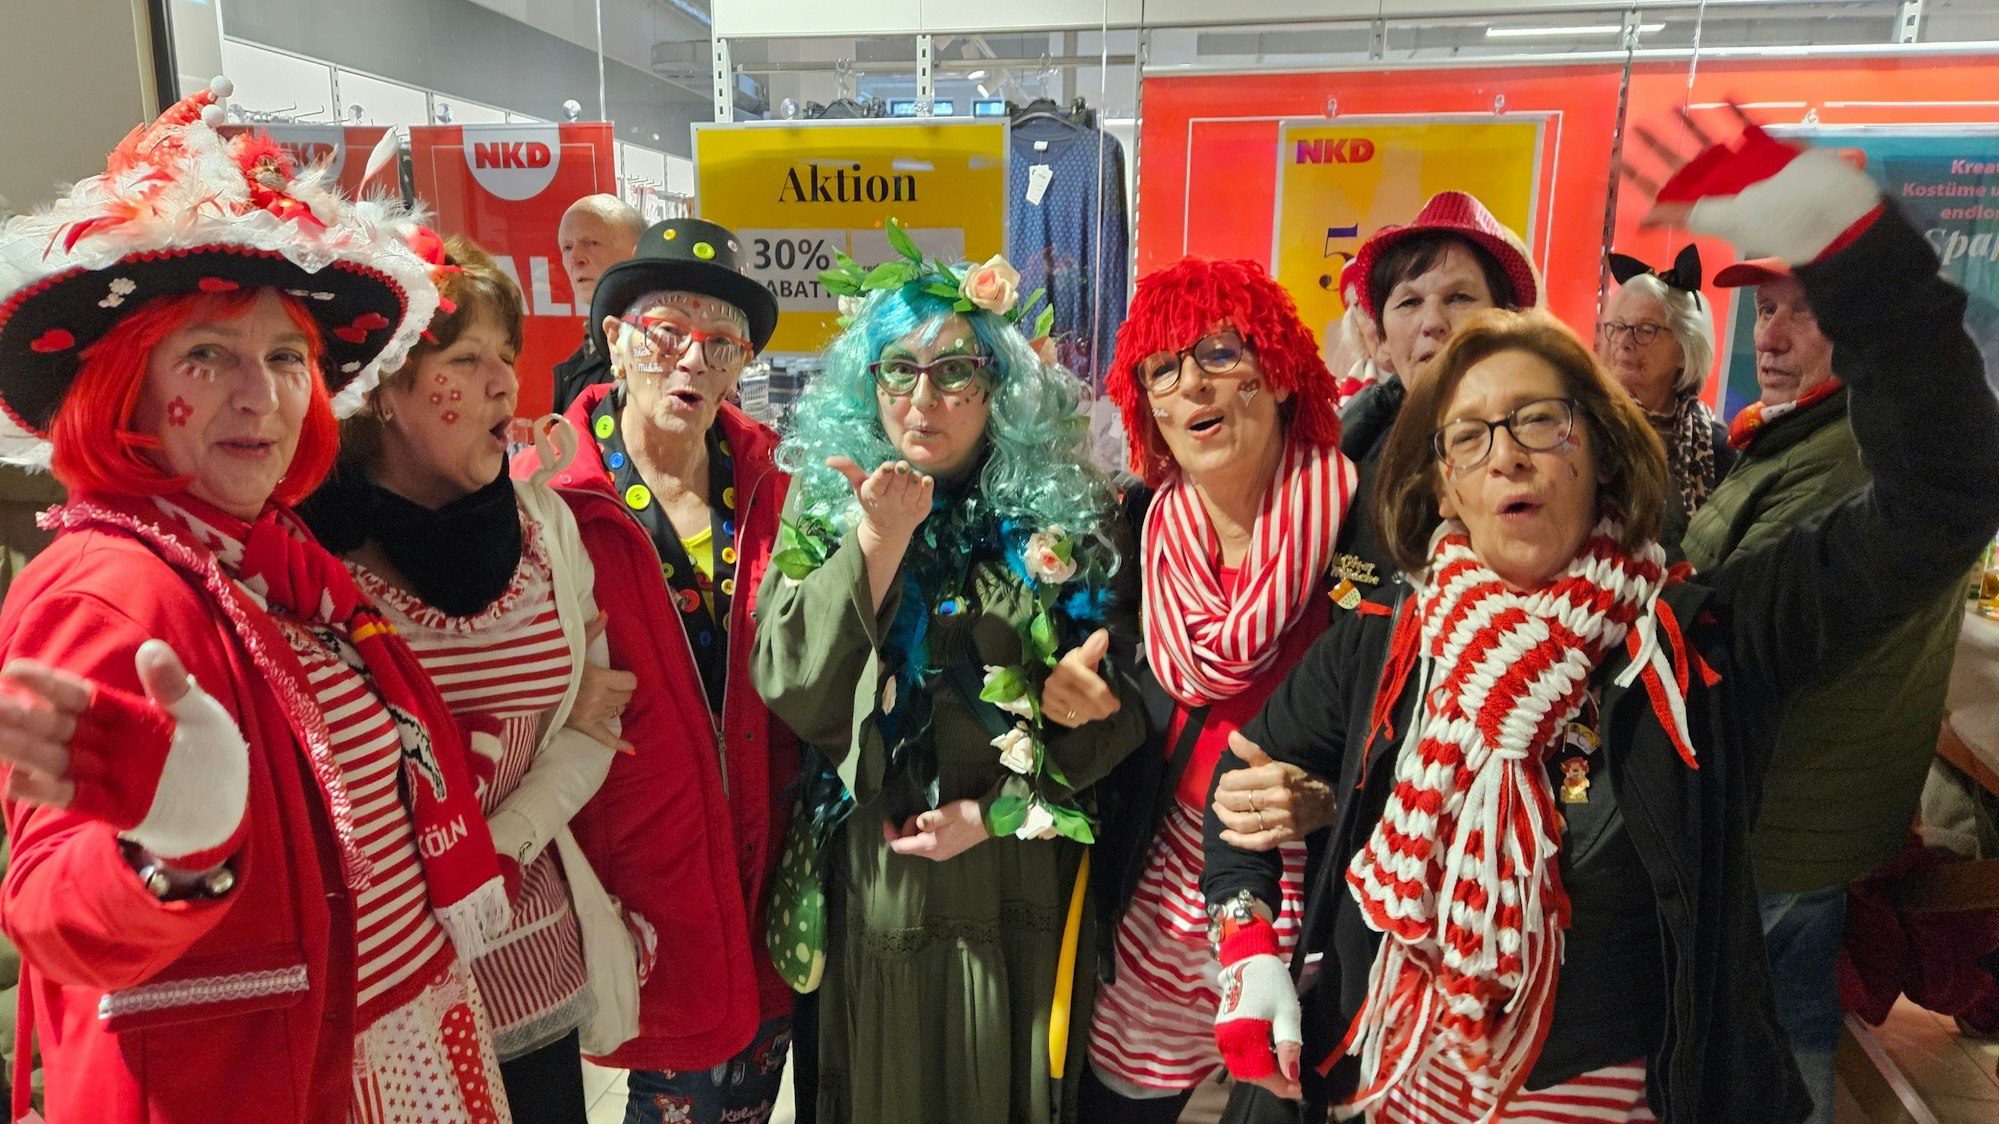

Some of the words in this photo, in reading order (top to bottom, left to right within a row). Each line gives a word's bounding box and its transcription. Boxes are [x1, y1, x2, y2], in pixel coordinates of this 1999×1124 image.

[474, 142, 552, 169] NKD
[1296, 138, 1375, 164] NKD
[1951, 159, 1999, 174] Krea
[777, 163, 919, 203] Aktion
[1904, 182, 1985, 197] Kostüme
[1991, 186, 1999, 197] u
[753, 238, 830, 270] 30%
[767, 279, 832, 299] ABAT
